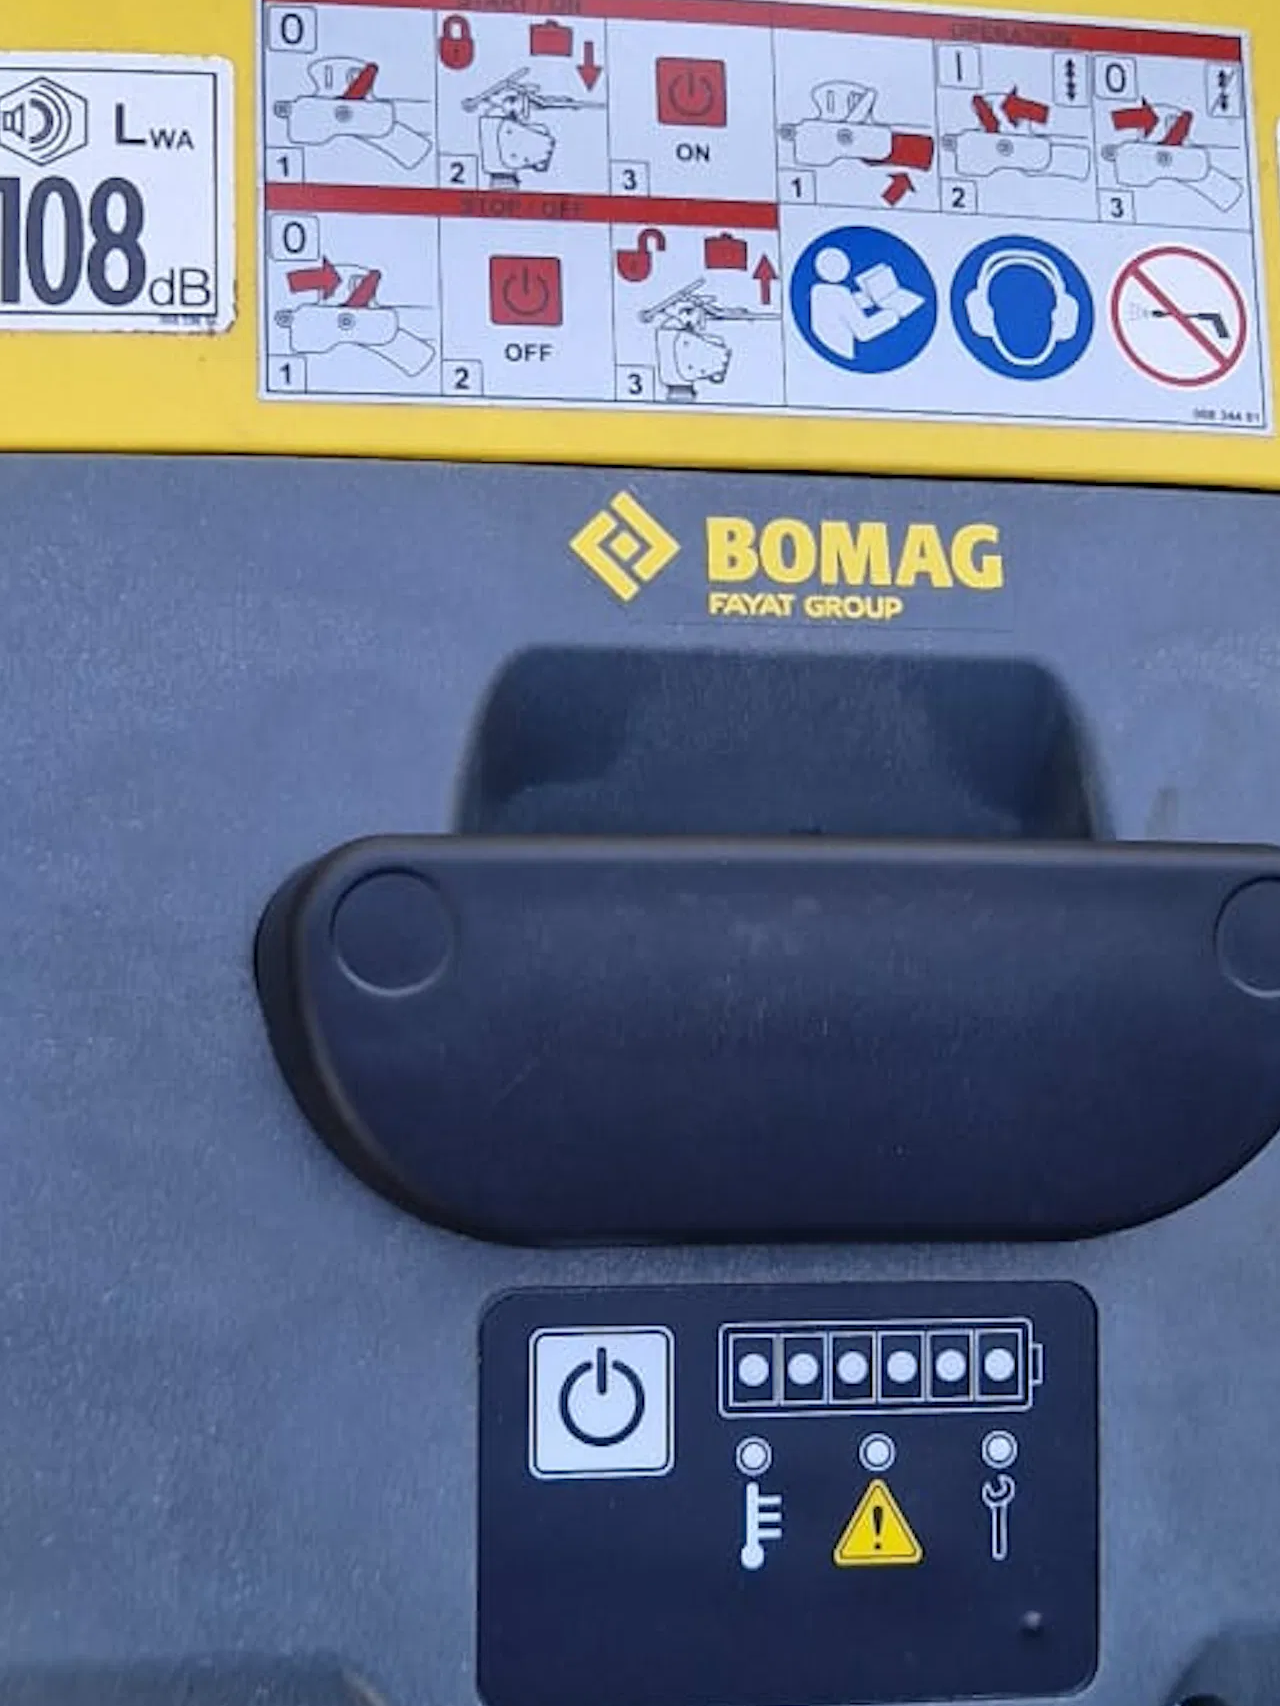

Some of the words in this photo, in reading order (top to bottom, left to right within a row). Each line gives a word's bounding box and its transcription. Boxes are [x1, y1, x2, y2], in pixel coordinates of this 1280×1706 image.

[676, 143, 710, 162] ON
[277, 156, 289, 177] 1
[450, 162, 465, 184] 2
[623, 169, 637, 190] 3
[792, 178, 801, 197] 1
[952, 187, 965, 208] 2
[1110, 198, 1125, 219] 3
[149, 268, 211, 306] dB
[504, 343, 552, 362] OFF
[280, 363, 290, 384] 1
[455, 367, 469, 389] 2
[628, 373, 643, 395] 3
[705, 516, 1004, 589] BOMAG
[708, 592, 796, 616] FAYAT
[805, 596, 903, 619] GROUP
